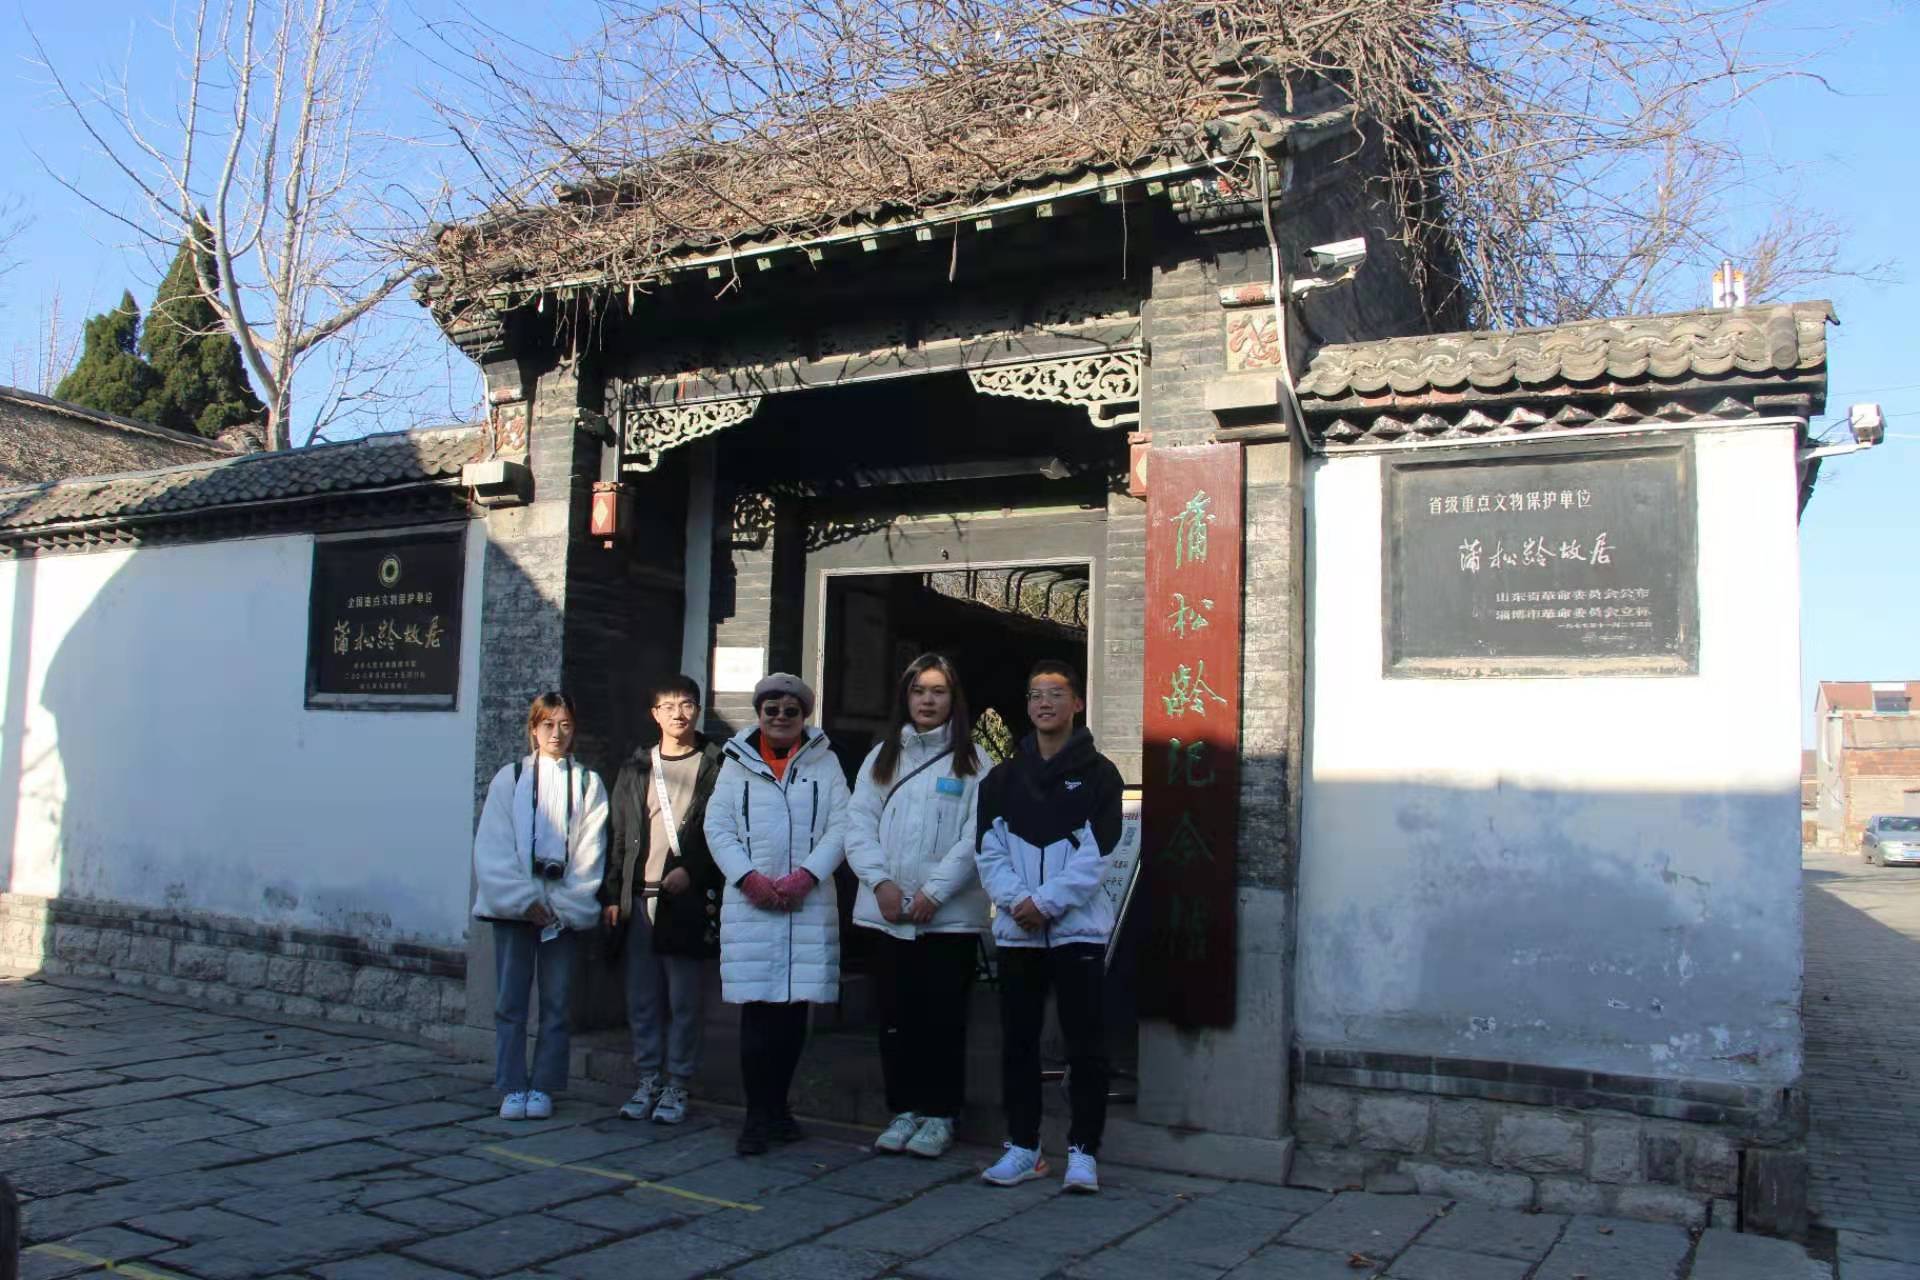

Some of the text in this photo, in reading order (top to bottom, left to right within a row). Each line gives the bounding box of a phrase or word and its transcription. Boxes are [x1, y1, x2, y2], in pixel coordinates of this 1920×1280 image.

[1429, 489, 1592, 515] 省级重点文物保护单位
[1459, 532, 1616, 573] 蒲松龄故居
[334, 615, 444, 655] 蒲松龄故居
